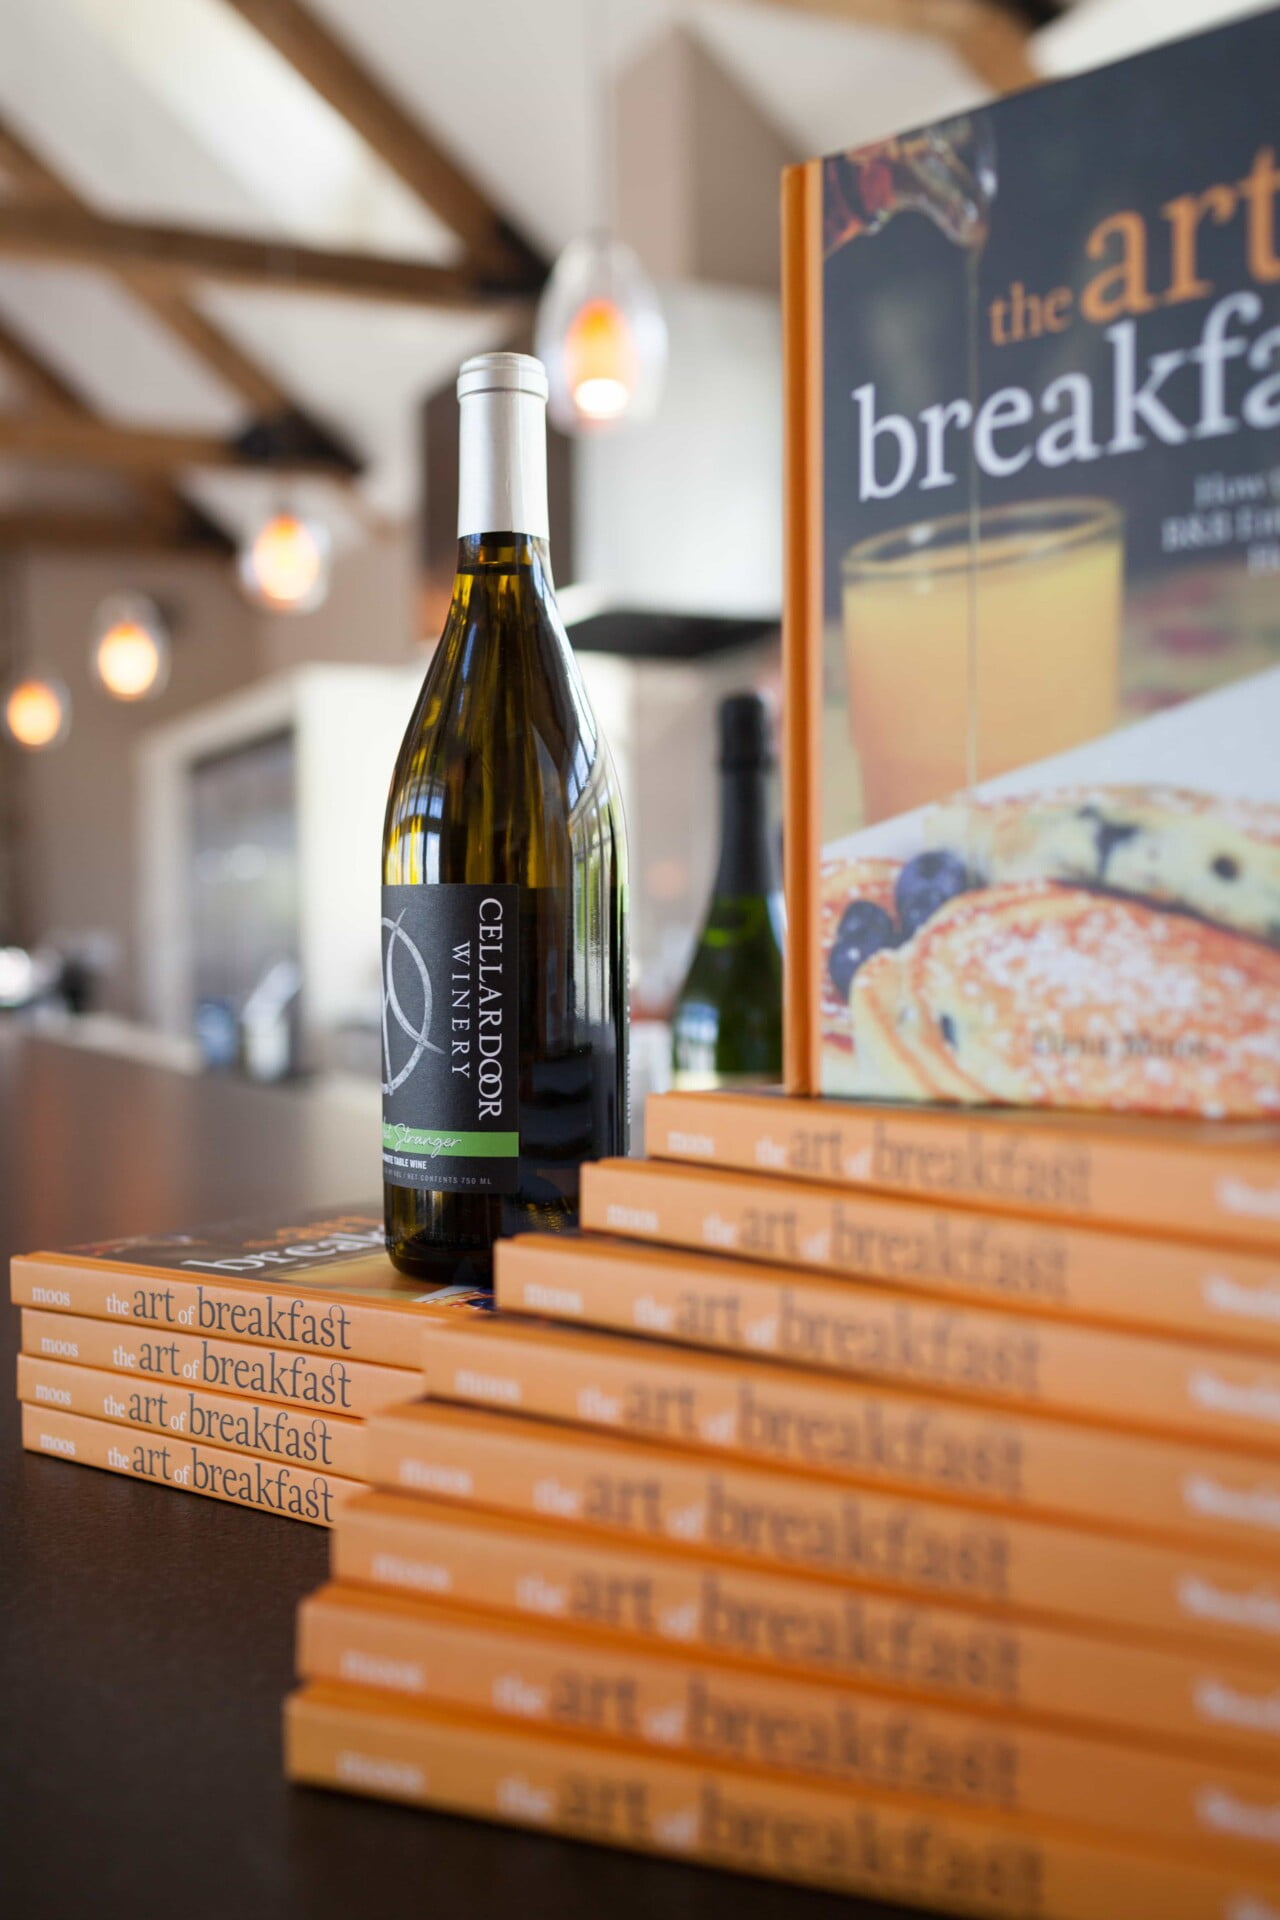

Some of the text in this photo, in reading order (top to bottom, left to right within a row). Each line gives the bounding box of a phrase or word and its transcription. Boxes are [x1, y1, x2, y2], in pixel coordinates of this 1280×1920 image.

[989, 145, 1280, 346] the art
[452, 940, 471, 1079] WINERY
[478, 897, 503, 1120] CELLARDOOR
[394, 1123, 462, 1158] Stranger
[409, 1159, 428, 1170] WINE
[420, 1174, 458, 1184] CONTENTS
[461, 1177, 477, 1185] 750
[480, 1177, 492, 1185] ML
[32, 1286, 71, 1306] moos
[106, 1286, 352, 1350] the art of breakfast
[41, 1336, 79, 1357] moos
[35, 1383, 72, 1406] moos
[112, 1341, 352, 1408] the art of breakfast
[40, 1433, 76, 1455] moos
[103, 1392, 333, 1465] the art of breakfast
[107, 1445, 335, 1523] the art of breakfast
